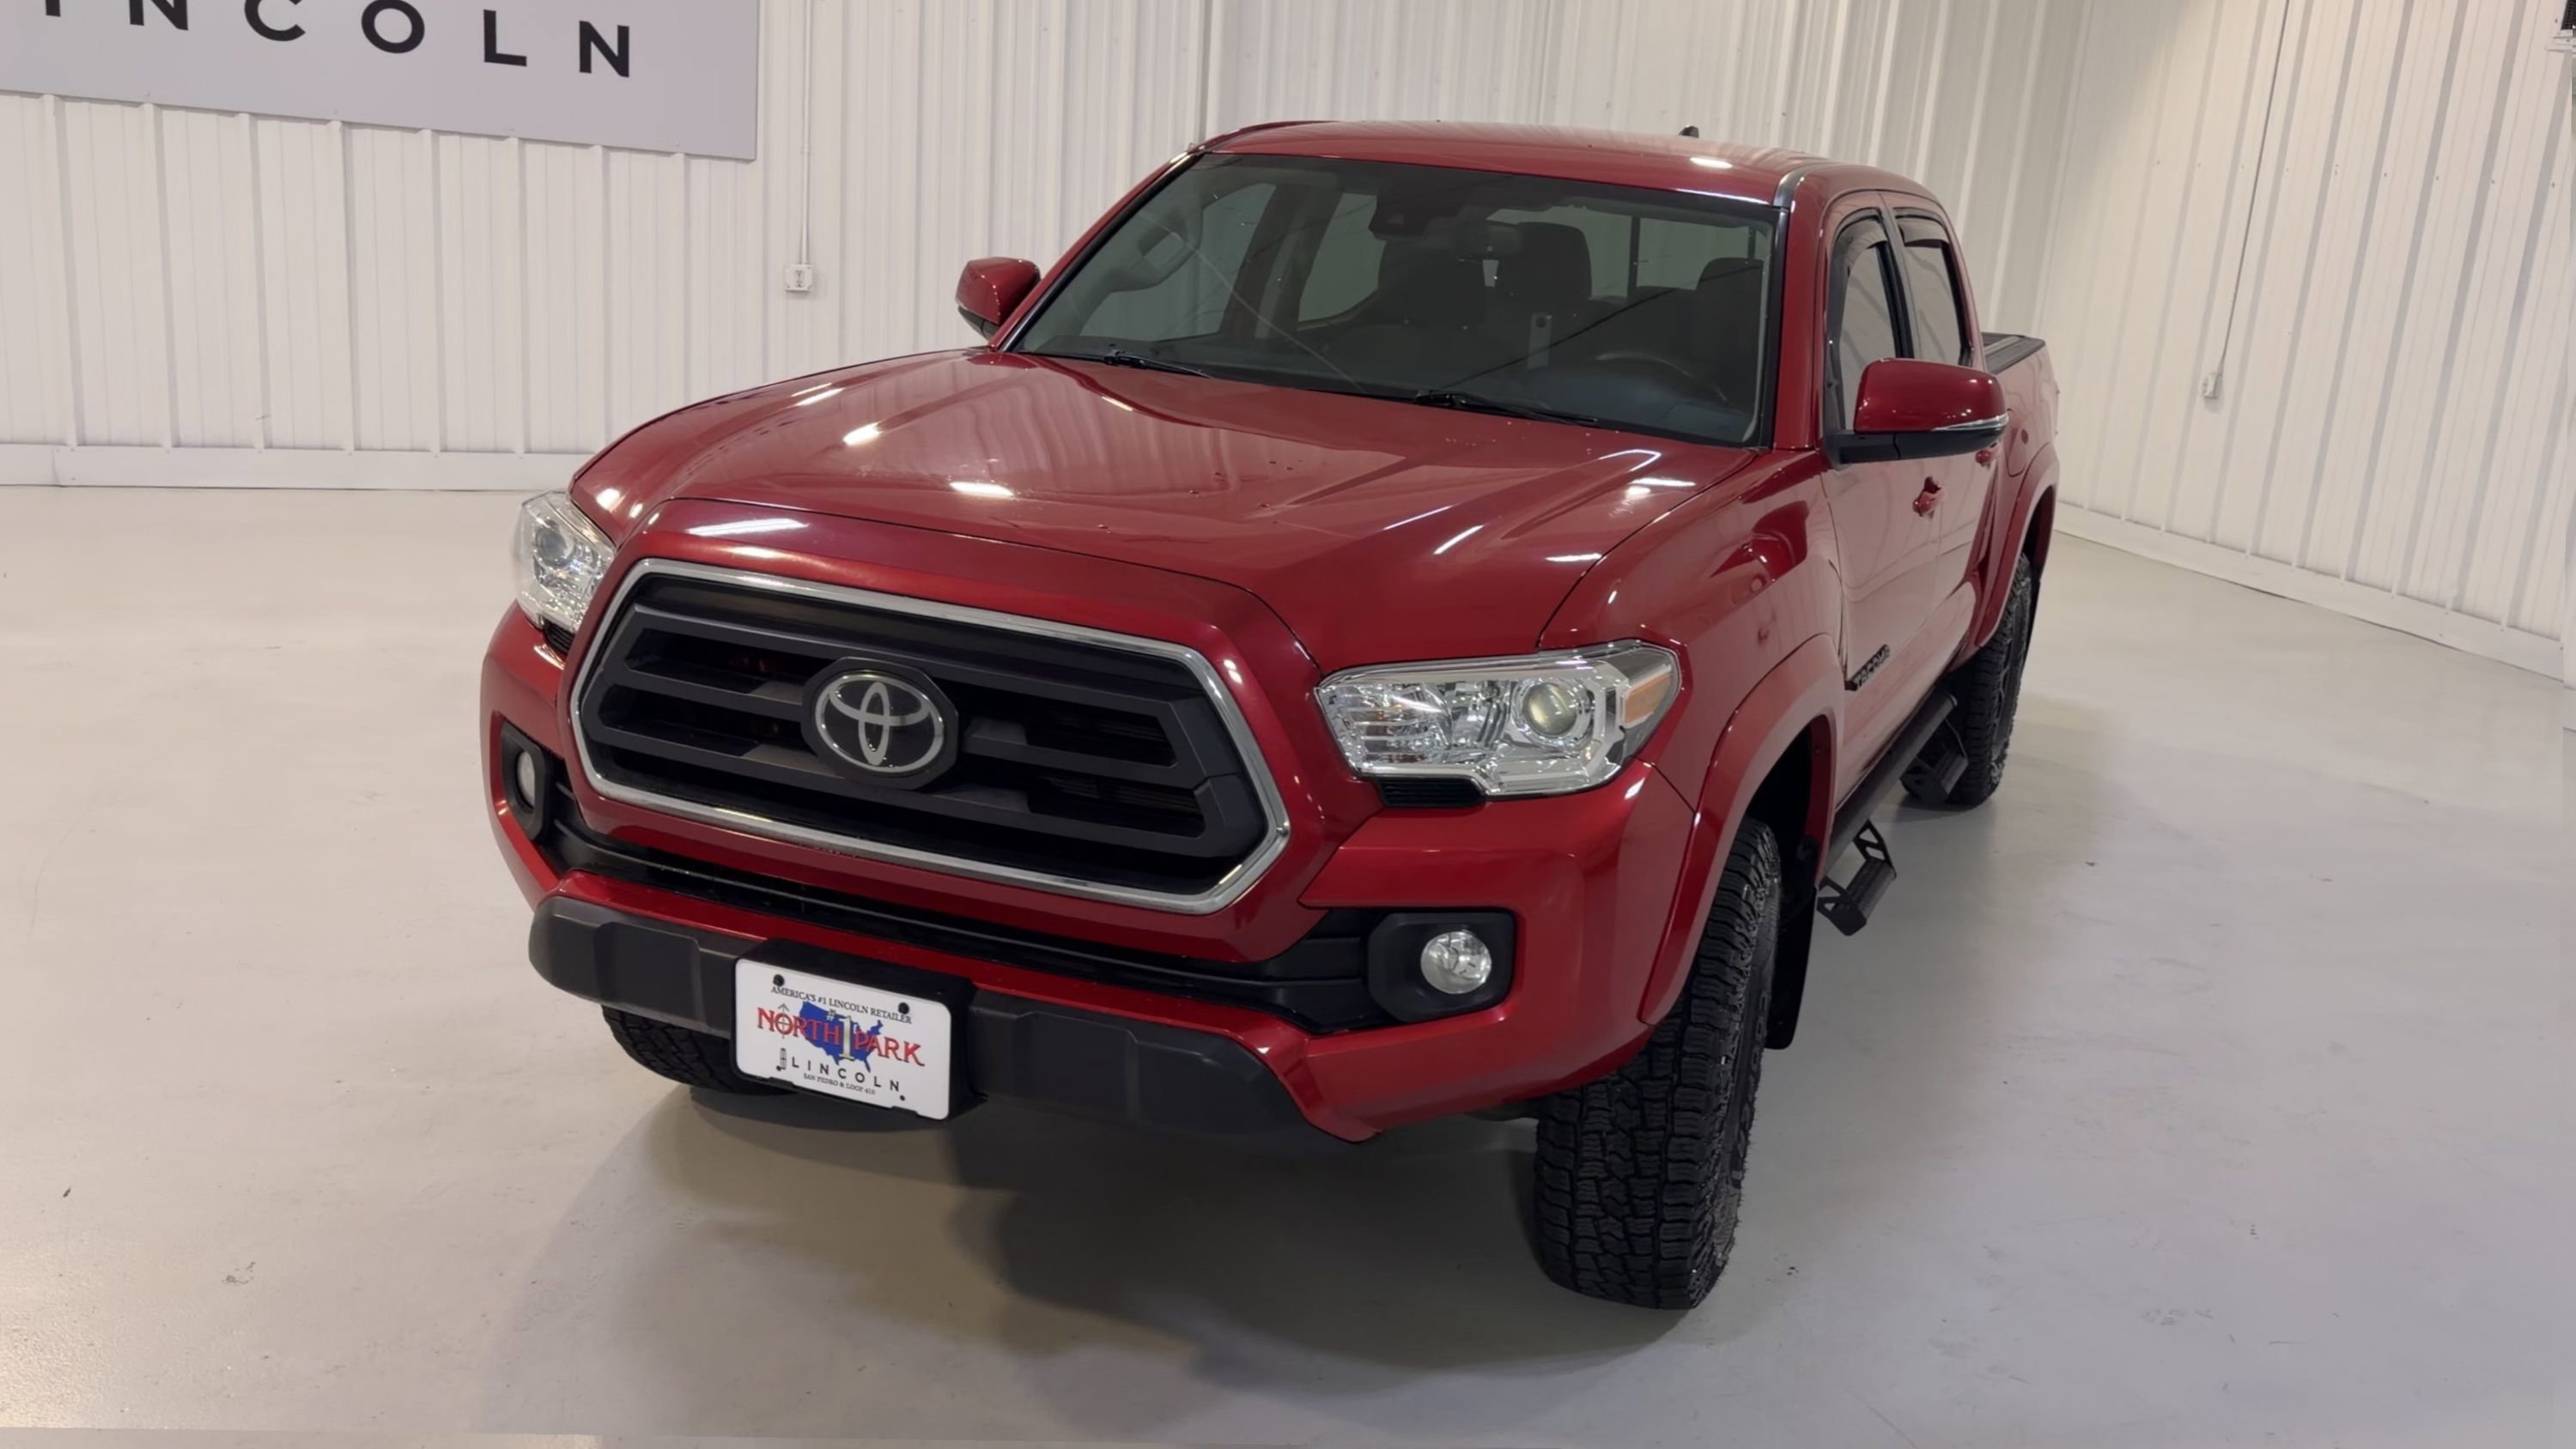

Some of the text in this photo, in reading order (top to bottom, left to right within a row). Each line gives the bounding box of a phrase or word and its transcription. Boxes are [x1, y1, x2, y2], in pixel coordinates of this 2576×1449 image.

[771, 985, 913, 1024] AMERICA'S #1 LINCOLN RETAILER
[756, 1007, 926, 1067] NORTH PARK
[792, 1057, 900, 1092] LINCOLN
[803, 1073, 816, 1082] SAN
[817, 1076, 838, 1088] PEDRO
